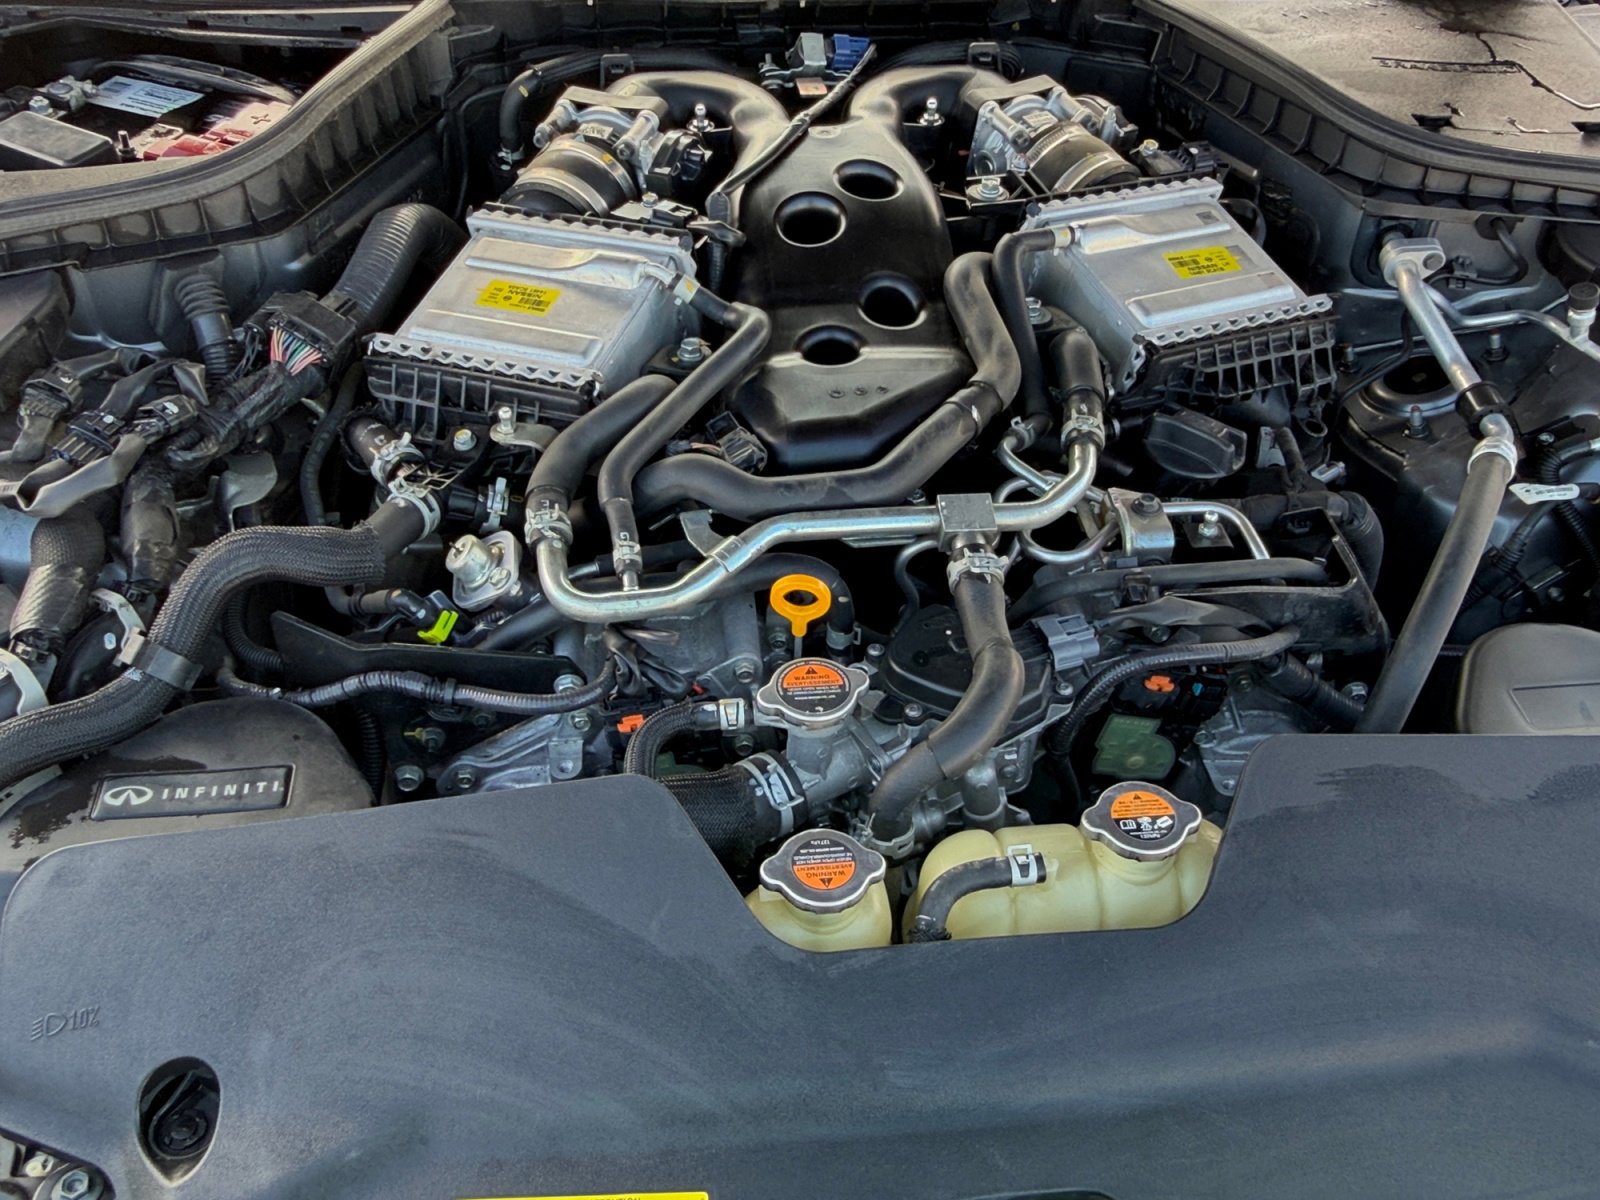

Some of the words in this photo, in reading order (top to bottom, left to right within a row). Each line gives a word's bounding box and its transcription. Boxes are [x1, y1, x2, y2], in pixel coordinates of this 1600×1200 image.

[508, 289, 543, 298] NISSAN
[161, 780, 280, 800] INFINITI
[797, 863, 853, 872] AVERTISSEMENT
[805, 870, 846, 878] WARNING
